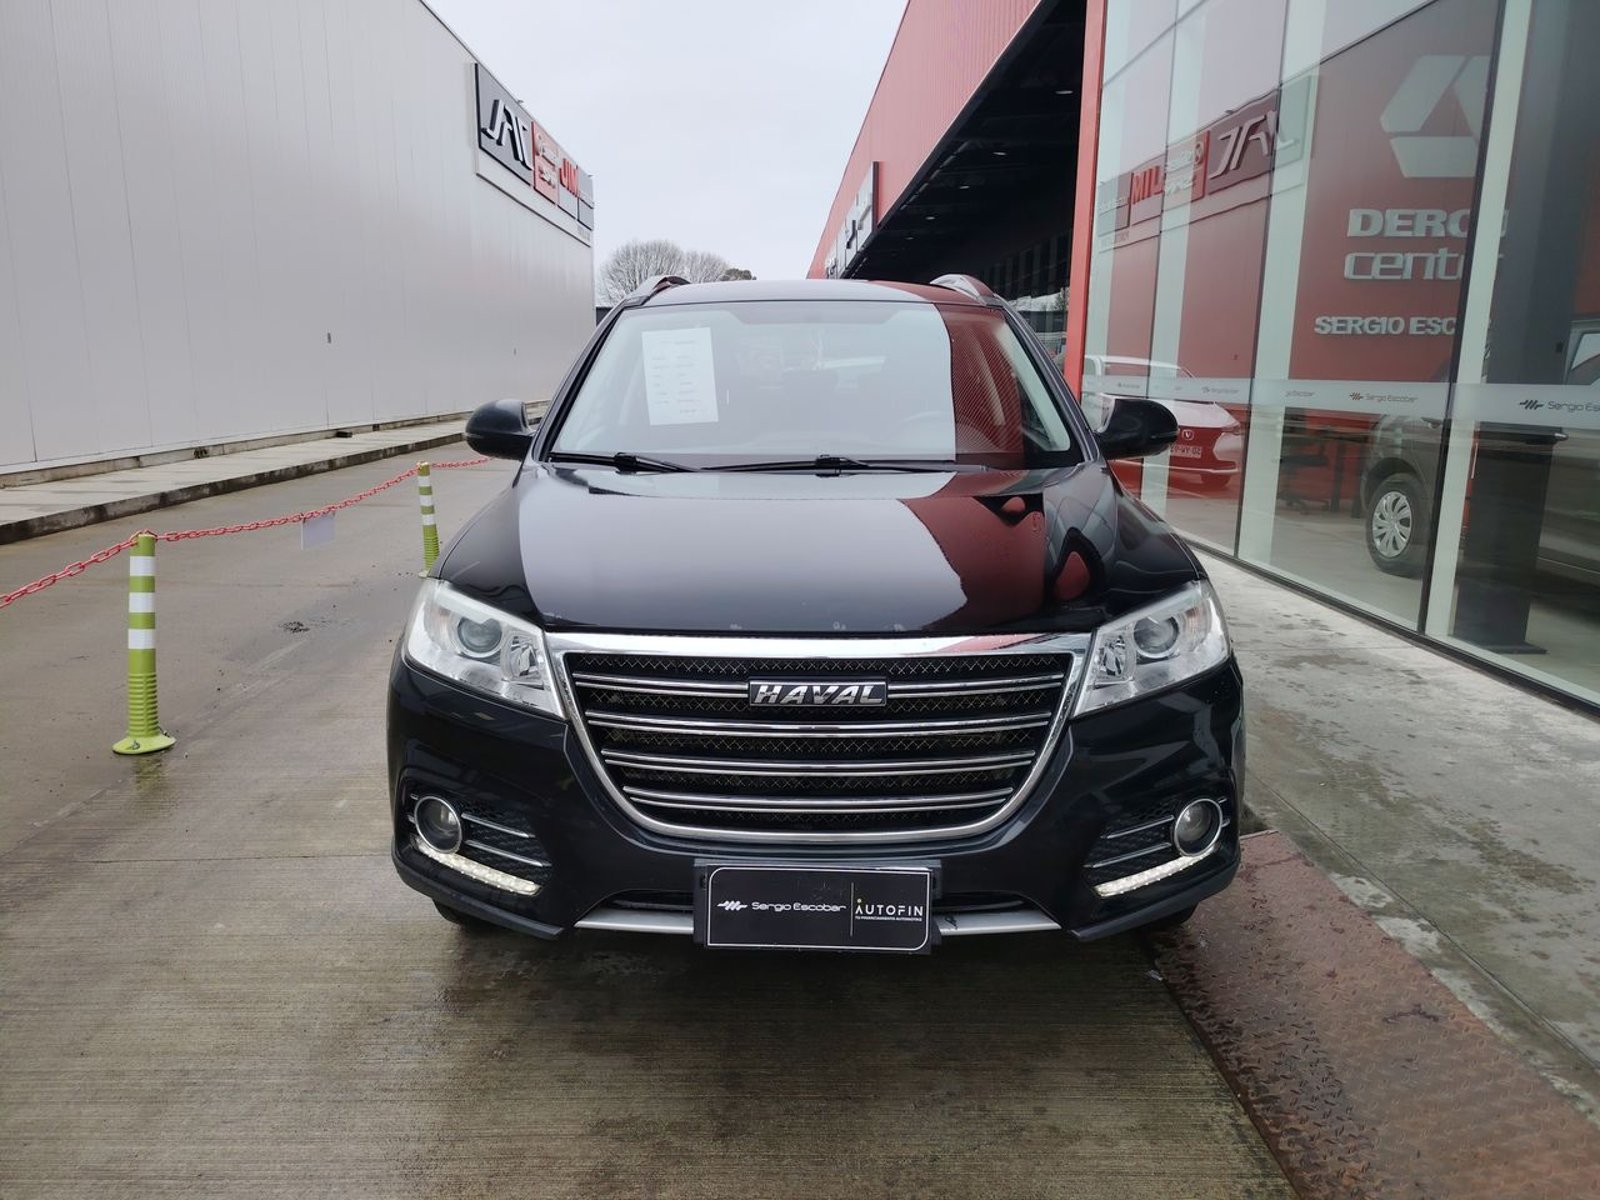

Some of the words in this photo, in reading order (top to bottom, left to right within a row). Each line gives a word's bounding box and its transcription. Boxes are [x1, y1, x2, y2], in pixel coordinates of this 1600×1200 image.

[1347, 208, 1508, 238] DERC
[1314, 316, 1405, 335] SERGIO
[753, 685, 883, 704] HAVAL
[793, 902, 847, 912] Escobar
[855, 900, 923, 916] AUTOFIN
